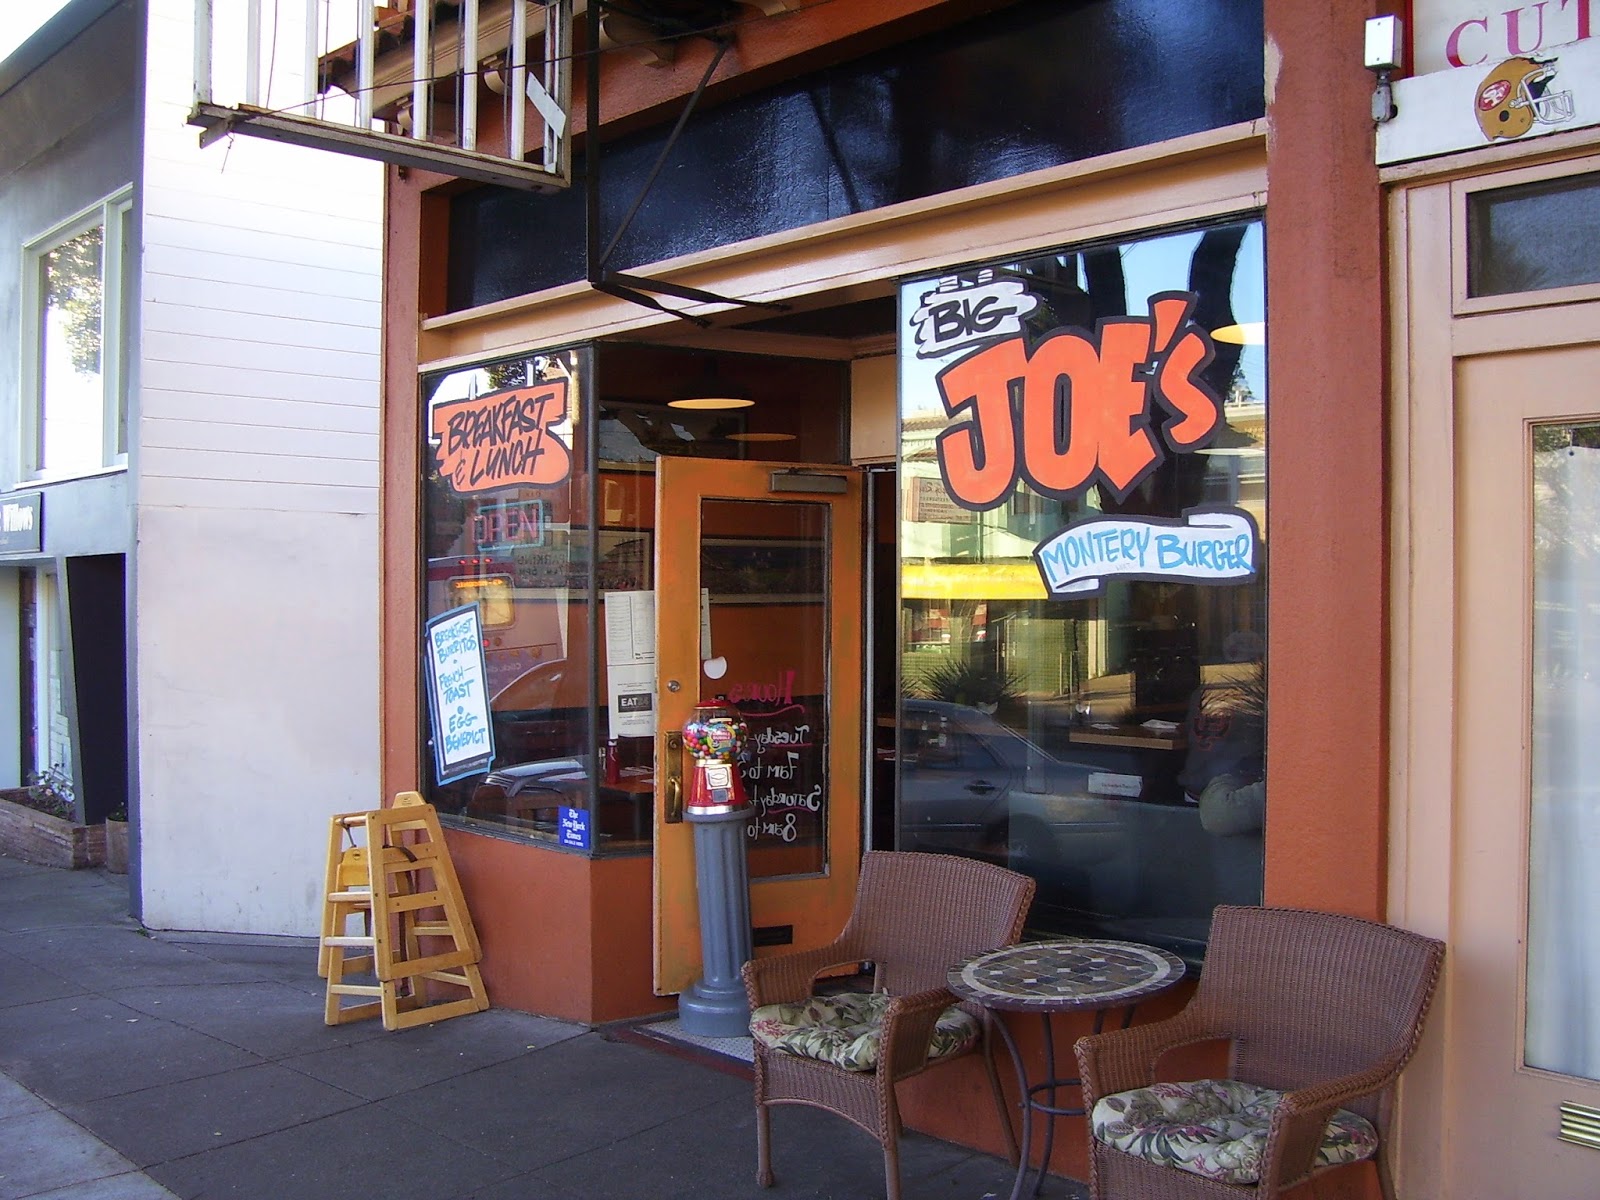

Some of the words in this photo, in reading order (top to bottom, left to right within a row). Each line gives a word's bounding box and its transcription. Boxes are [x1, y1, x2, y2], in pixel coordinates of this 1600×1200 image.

[1446, 0, 1600, 68] CUT
[928, 296, 1017, 344] BIG
[447, 393, 555, 455] BREAKFAST
[469, 435, 545, 486] LUNCH
[471, 508, 539, 542] OPEN
[1043, 527, 1151, 584] MONTERY
[1155, 533, 1256, 575] BURGER
[434, 617, 474, 648] BREAKFAST
[437, 635, 477, 664] BURRITOS
[443, 679, 475, 706] TOAST
[449, 714, 478, 733] EGG
[445, 728, 486, 755] BENEDICT
[562, 817, 573, 828] New
[573, 819, 585, 831] York
[569, 808, 579, 819] The
[566, 829, 581, 841] Times
